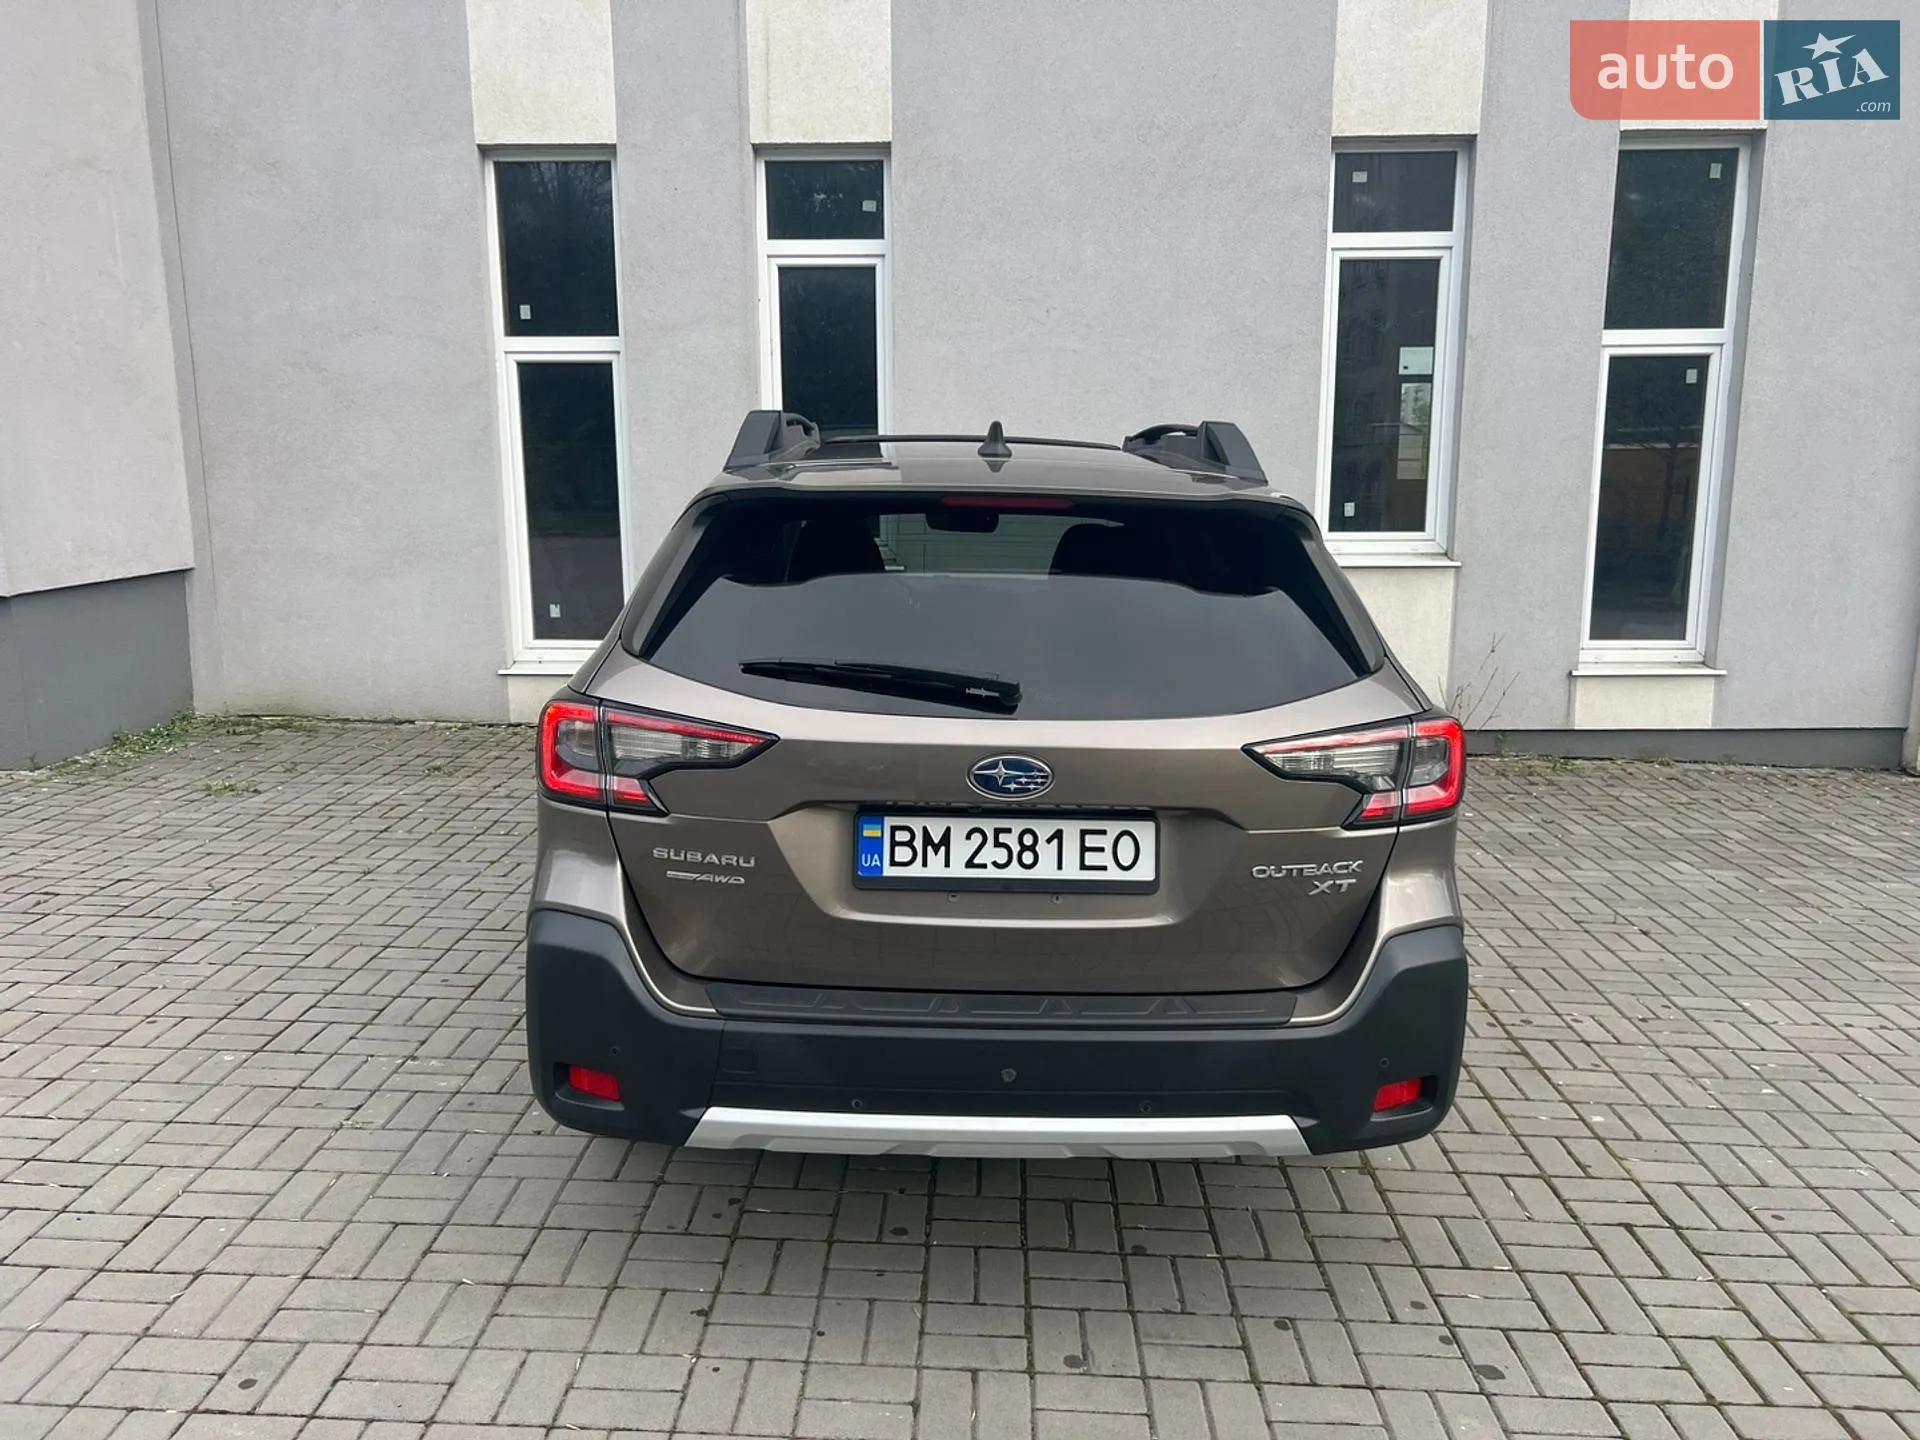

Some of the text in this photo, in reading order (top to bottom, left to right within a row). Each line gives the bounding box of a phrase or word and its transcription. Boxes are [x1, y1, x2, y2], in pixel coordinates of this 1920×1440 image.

[889, 825, 1141, 871] BM 2581 EO
[652, 847, 756, 868] SUBARU
[861, 855, 881, 867] UA
[1251, 860, 1364, 878] OUTBACK
[697, 873, 745, 884] AWD
[1307, 879, 1357, 895] XT
